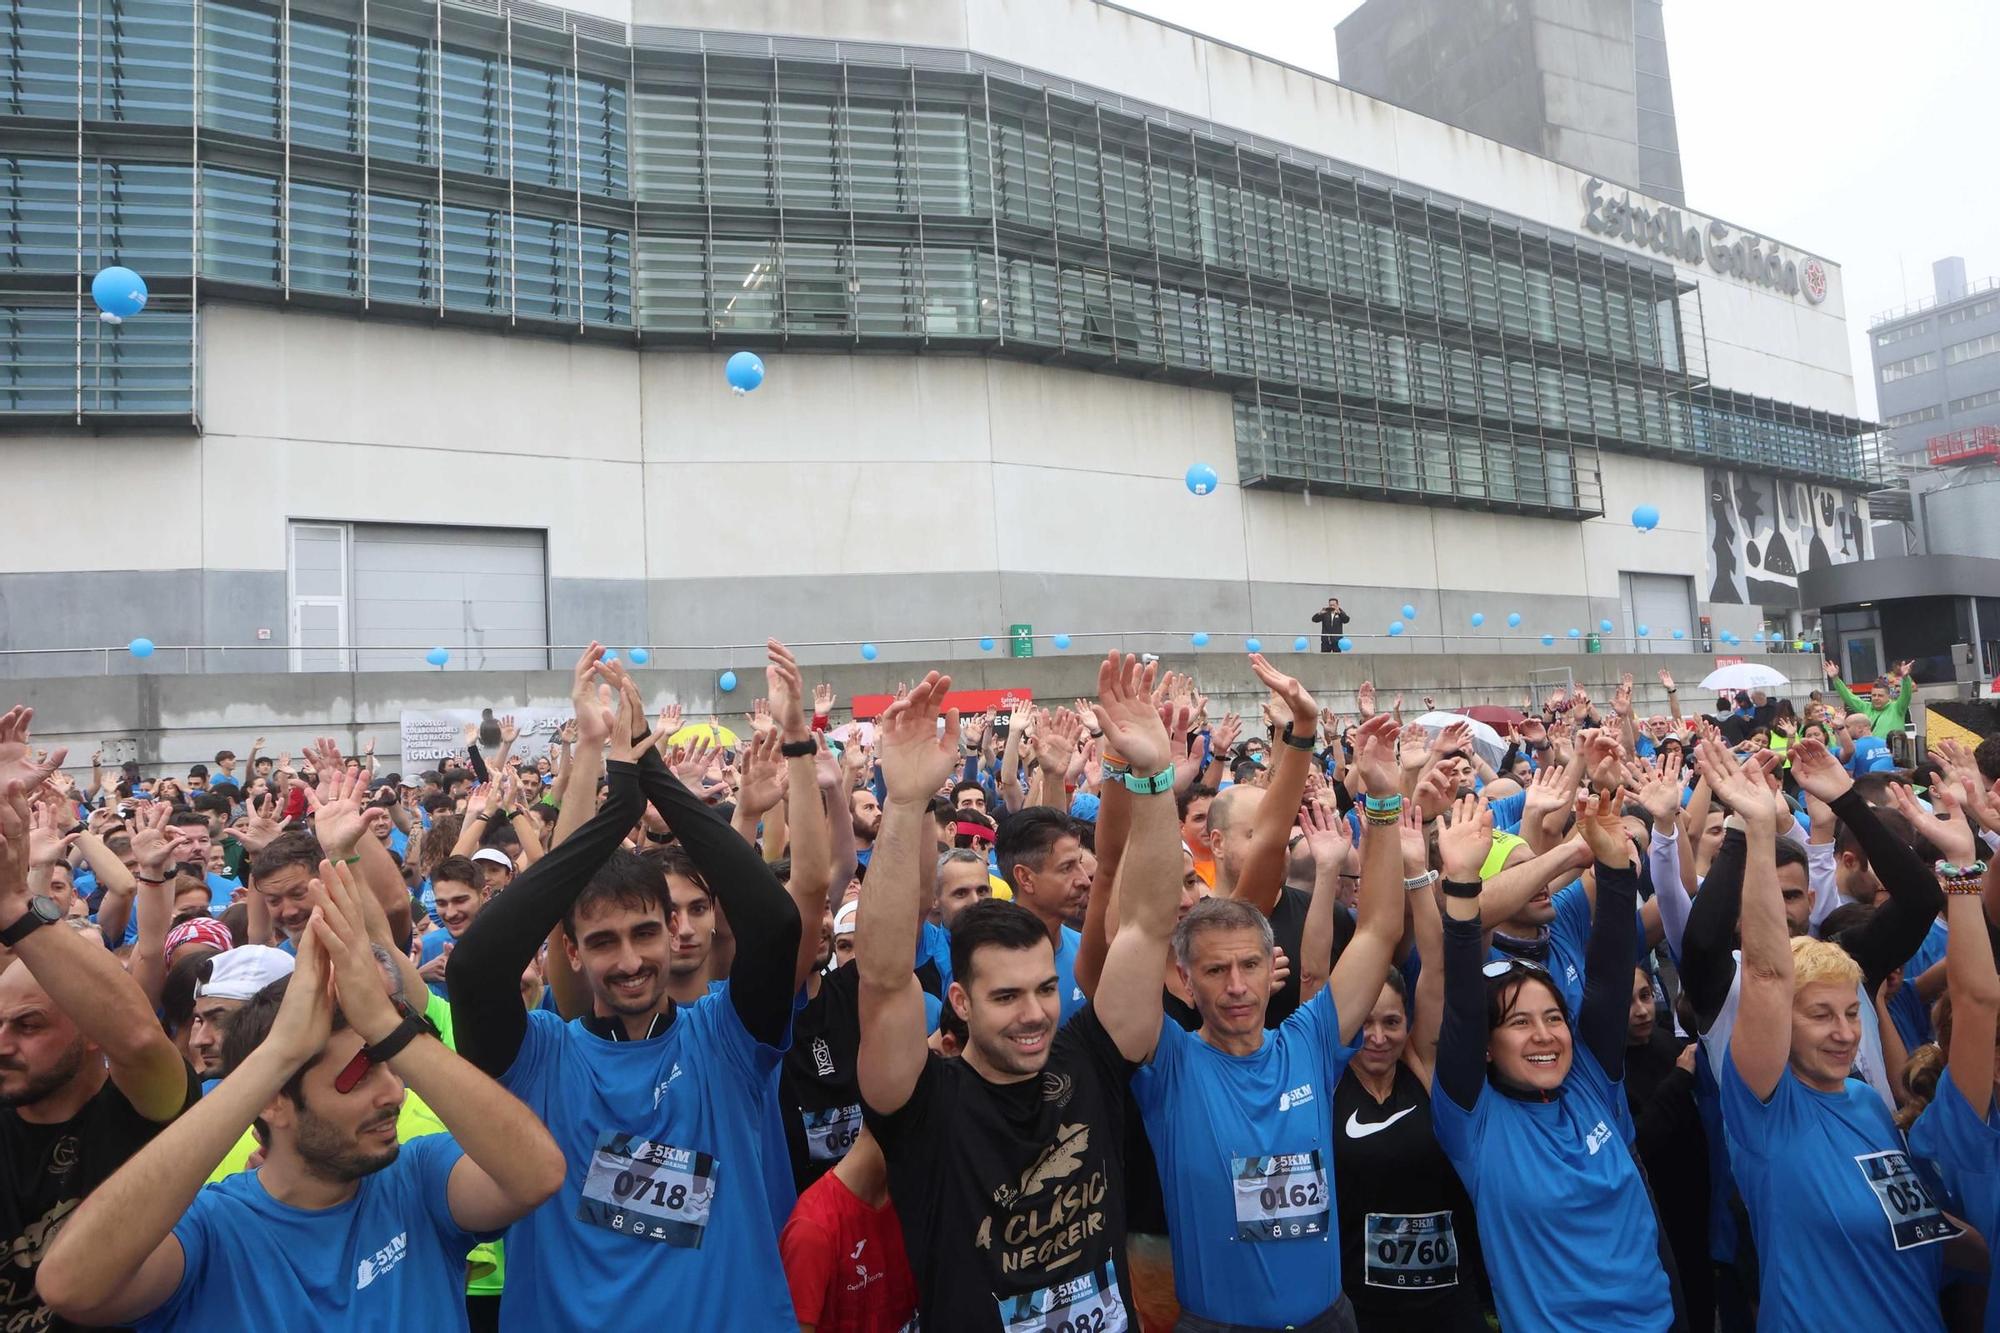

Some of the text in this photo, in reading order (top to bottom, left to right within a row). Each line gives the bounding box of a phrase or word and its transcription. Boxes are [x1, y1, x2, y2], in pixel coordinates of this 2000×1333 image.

[1581, 176, 1800, 297] Estrella Galicia
[654, 1144, 691, 1164] 5KM
[1280, 1154, 1311, 1167] 5KM
[614, 1170, 687, 1210] 0718
[1260, 1182, 1320, 1211] 0162
[1004, 1171, 1107, 1245] CLÁSIC
[1003, 1212, 1107, 1273] NEGREIR
[1378, 1238, 1449, 1265] 0760
[1058, 1275, 1092, 1297] 5KM
